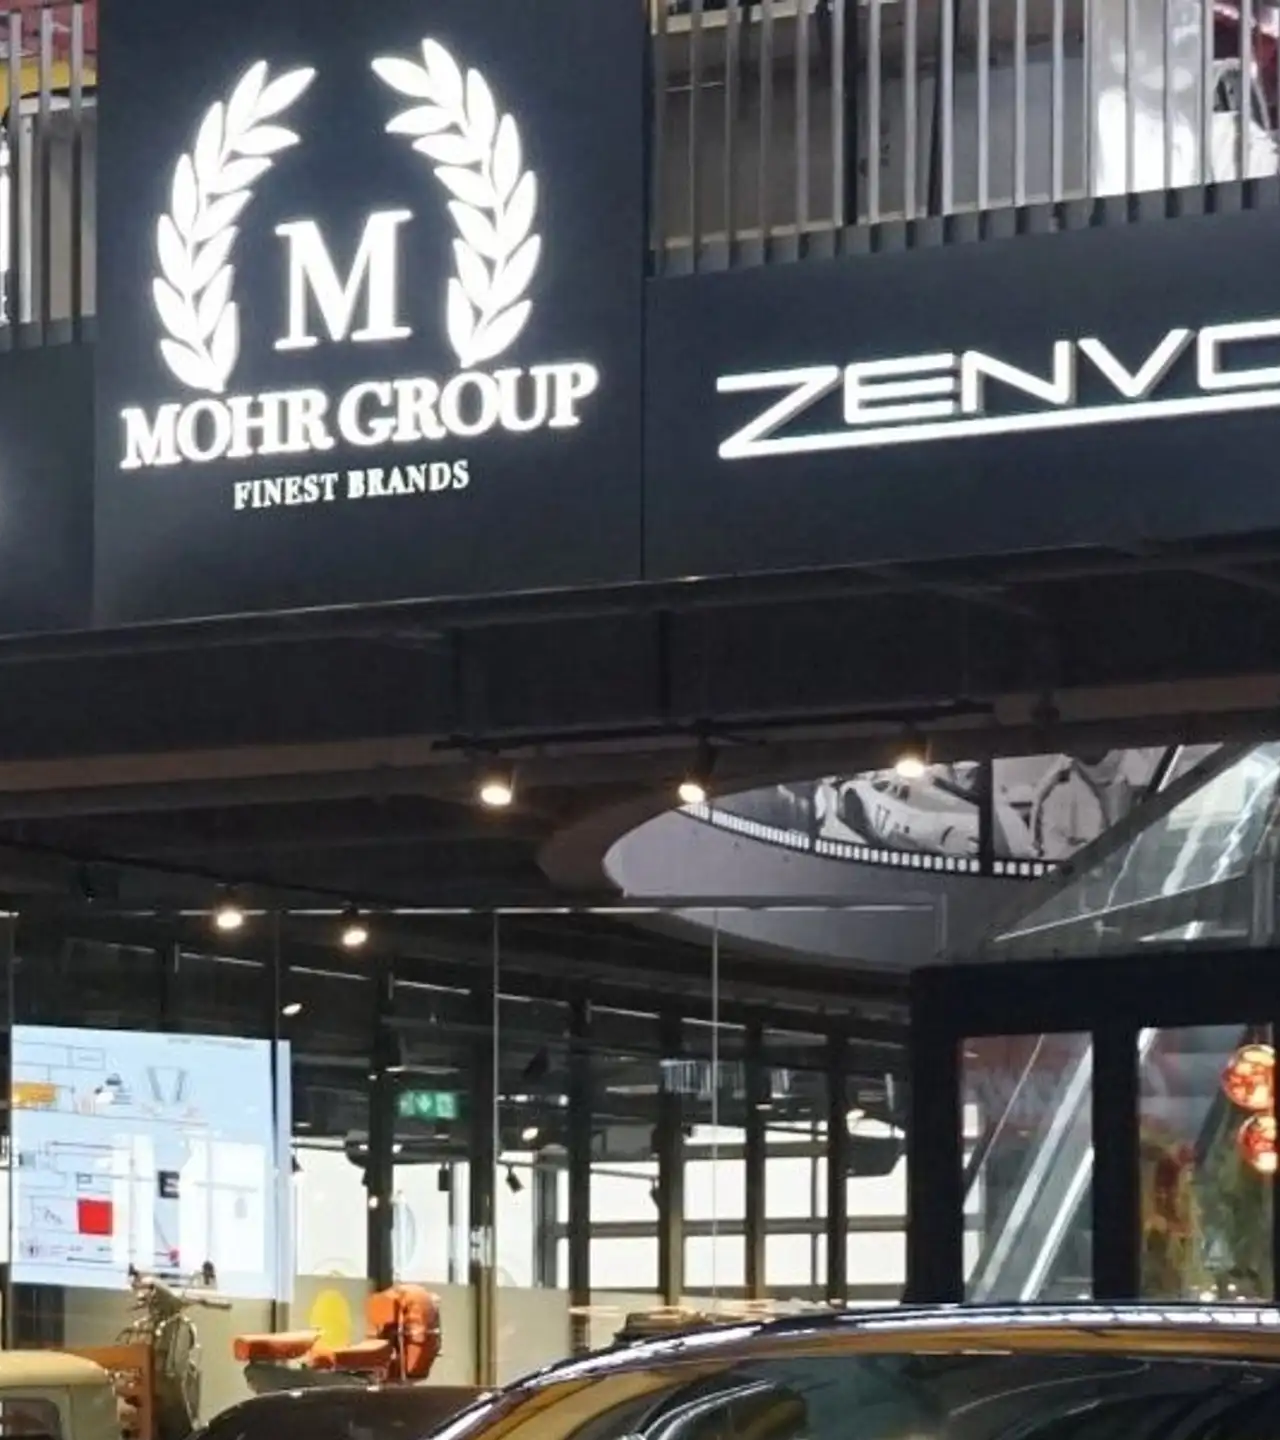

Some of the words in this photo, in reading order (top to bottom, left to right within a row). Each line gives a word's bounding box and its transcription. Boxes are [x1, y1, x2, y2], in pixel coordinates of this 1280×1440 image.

[274, 209, 414, 351] M
[119, 388, 335, 469] MOHR
[337, 362, 599, 446] GROUP
[233, 472, 340, 510] FINEST
[347, 459, 470, 499] BRANDS
